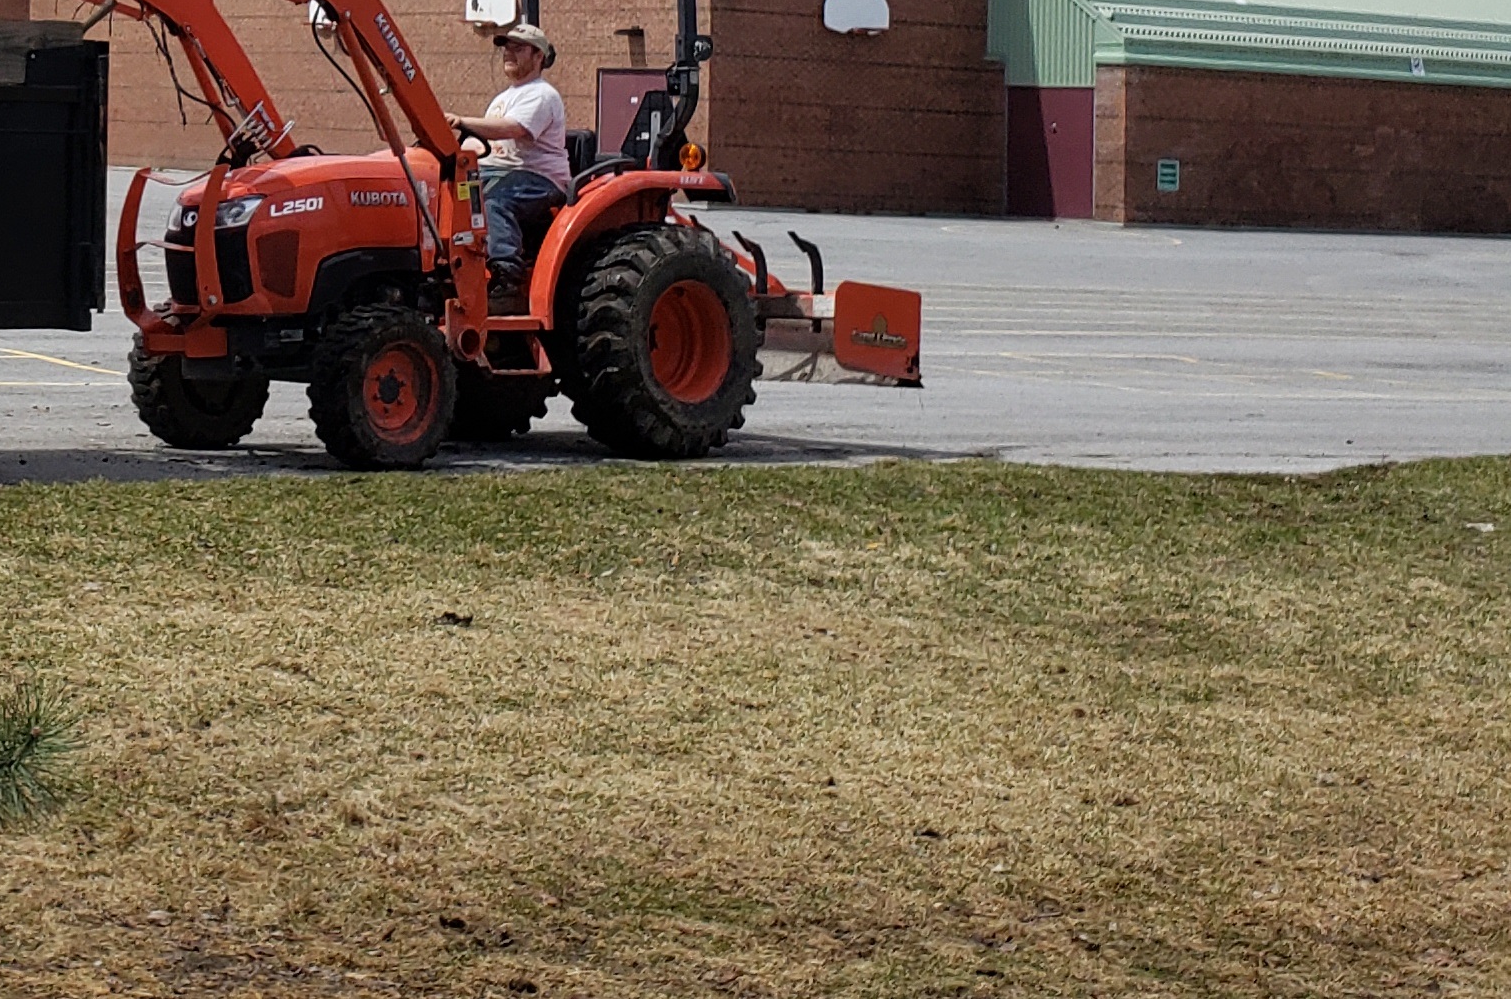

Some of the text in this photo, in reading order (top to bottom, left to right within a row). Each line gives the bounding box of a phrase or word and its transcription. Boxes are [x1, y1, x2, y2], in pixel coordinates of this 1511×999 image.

[374, 12, 417, 84] KUBOTA
[270, 196, 324, 218] L2501
[350, 190, 408, 206] KUBOTA
